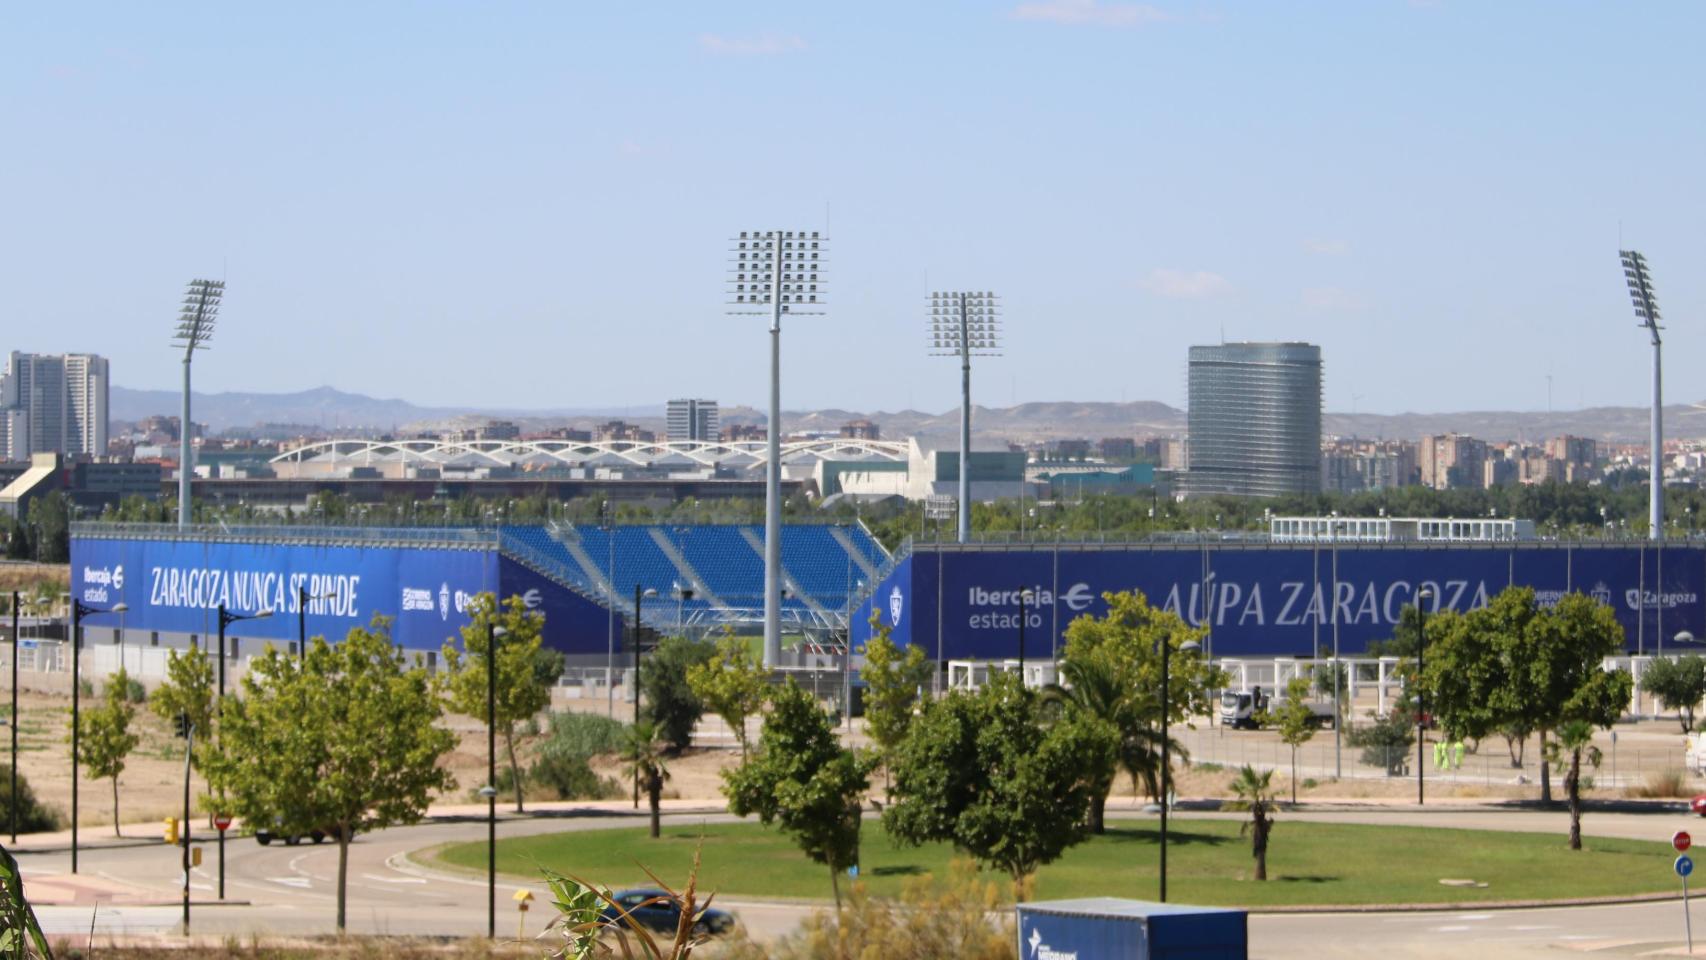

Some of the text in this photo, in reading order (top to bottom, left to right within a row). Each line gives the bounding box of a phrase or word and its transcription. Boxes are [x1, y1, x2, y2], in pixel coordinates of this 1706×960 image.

[150, 566, 230, 610] ZARAGOZA
[232, 570, 285, 613] NUNCA
[308, 573, 360, 617] RINDE
[968, 585, 1054, 609] Ibercaja
[1162, 571, 1489, 626] AÚPA ZARAGOZA
[1643, 590, 1697, 608] Zaragoza
